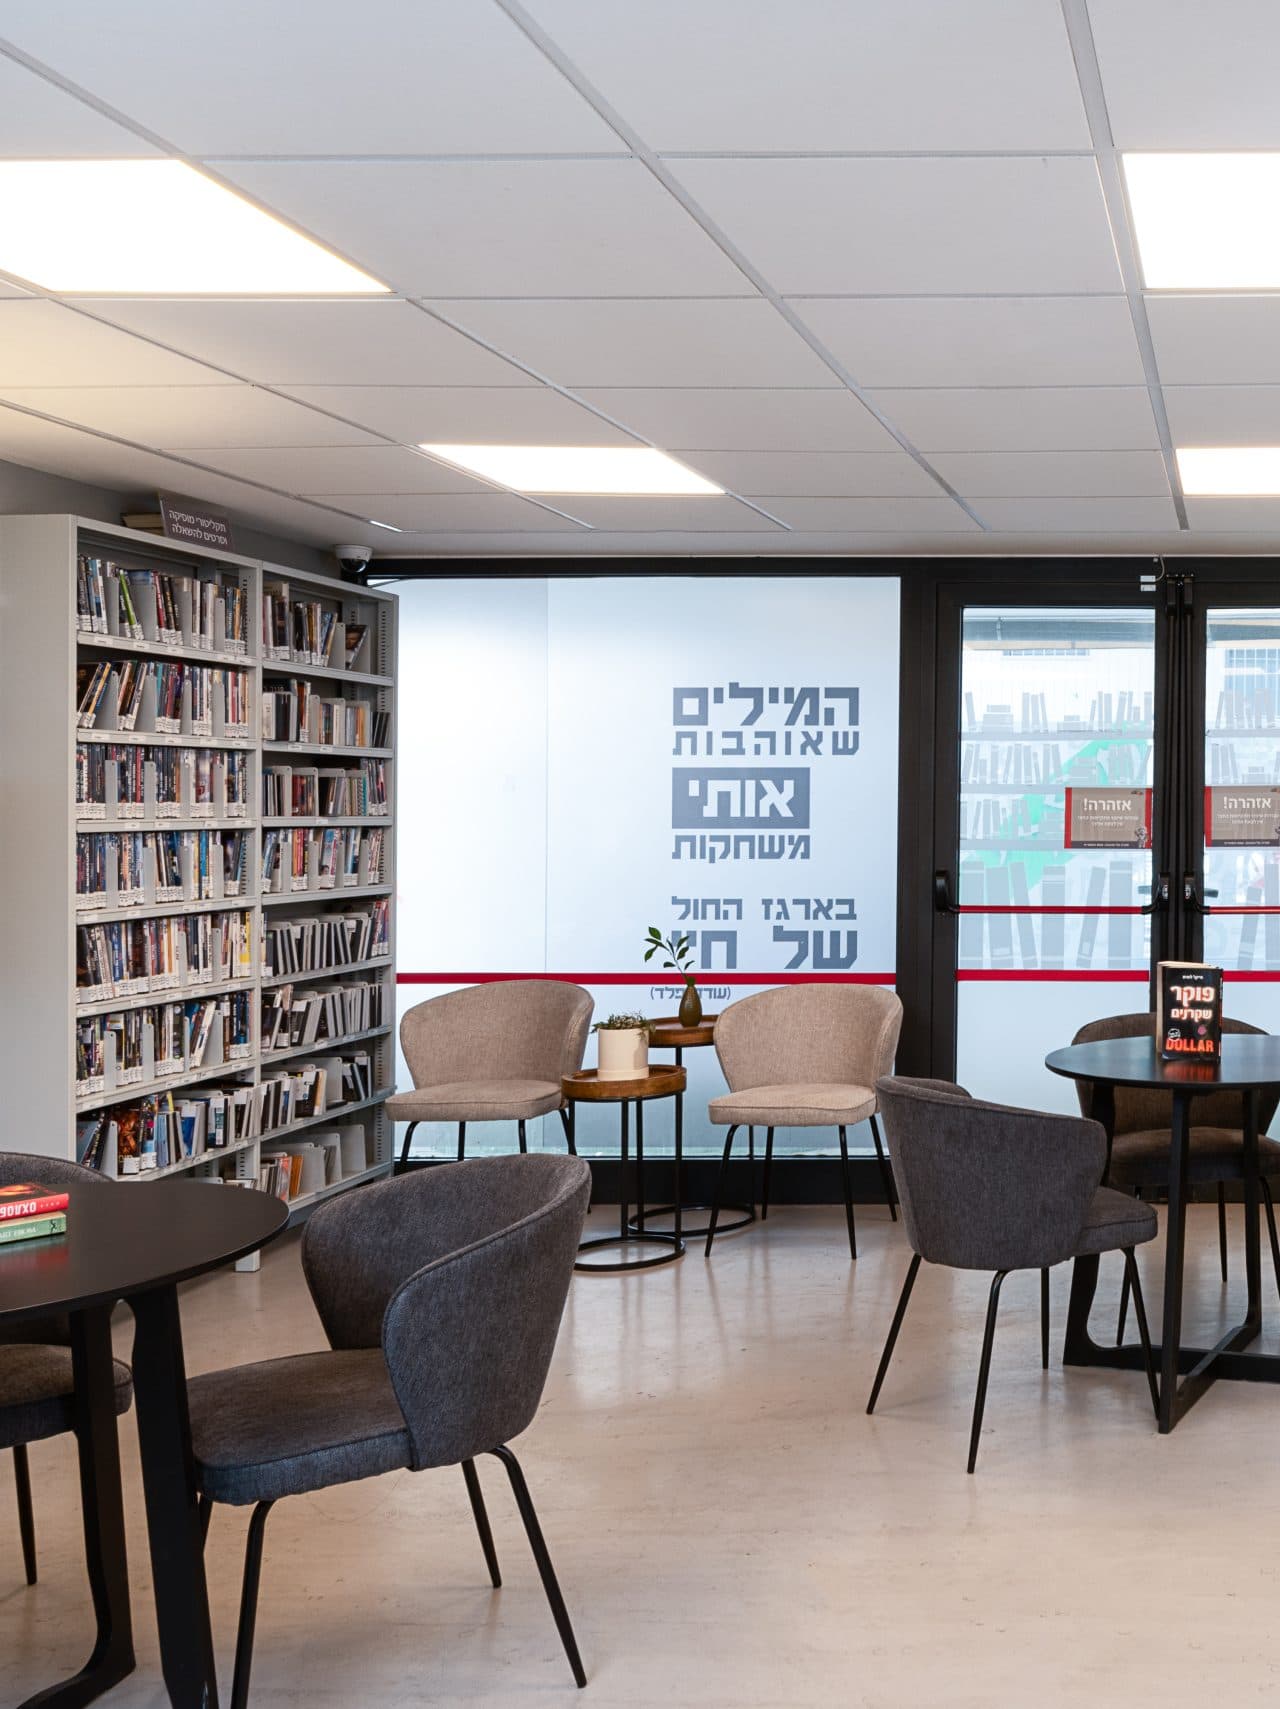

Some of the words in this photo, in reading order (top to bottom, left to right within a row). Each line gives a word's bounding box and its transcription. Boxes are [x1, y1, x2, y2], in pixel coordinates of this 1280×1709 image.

[672, 682, 859, 726] המילים
[672, 731, 859, 756] שאוהבות
[688, 780, 794, 818] אותי
[1083, 798, 1132, 812] אזהרה!
[1224, 796, 1272, 810] אזהרה!
[672, 834, 811, 864] משחקות
[671, 896, 743, 920] החול
[761, 898, 858, 920] בארגז
[772, 925, 858, 970] של
[1170, 985, 1216, 1007] פוקר
[1170, 1008, 1213, 1022] שקרנים
[1166, 1038, 1214, 1052] DOLLAR
